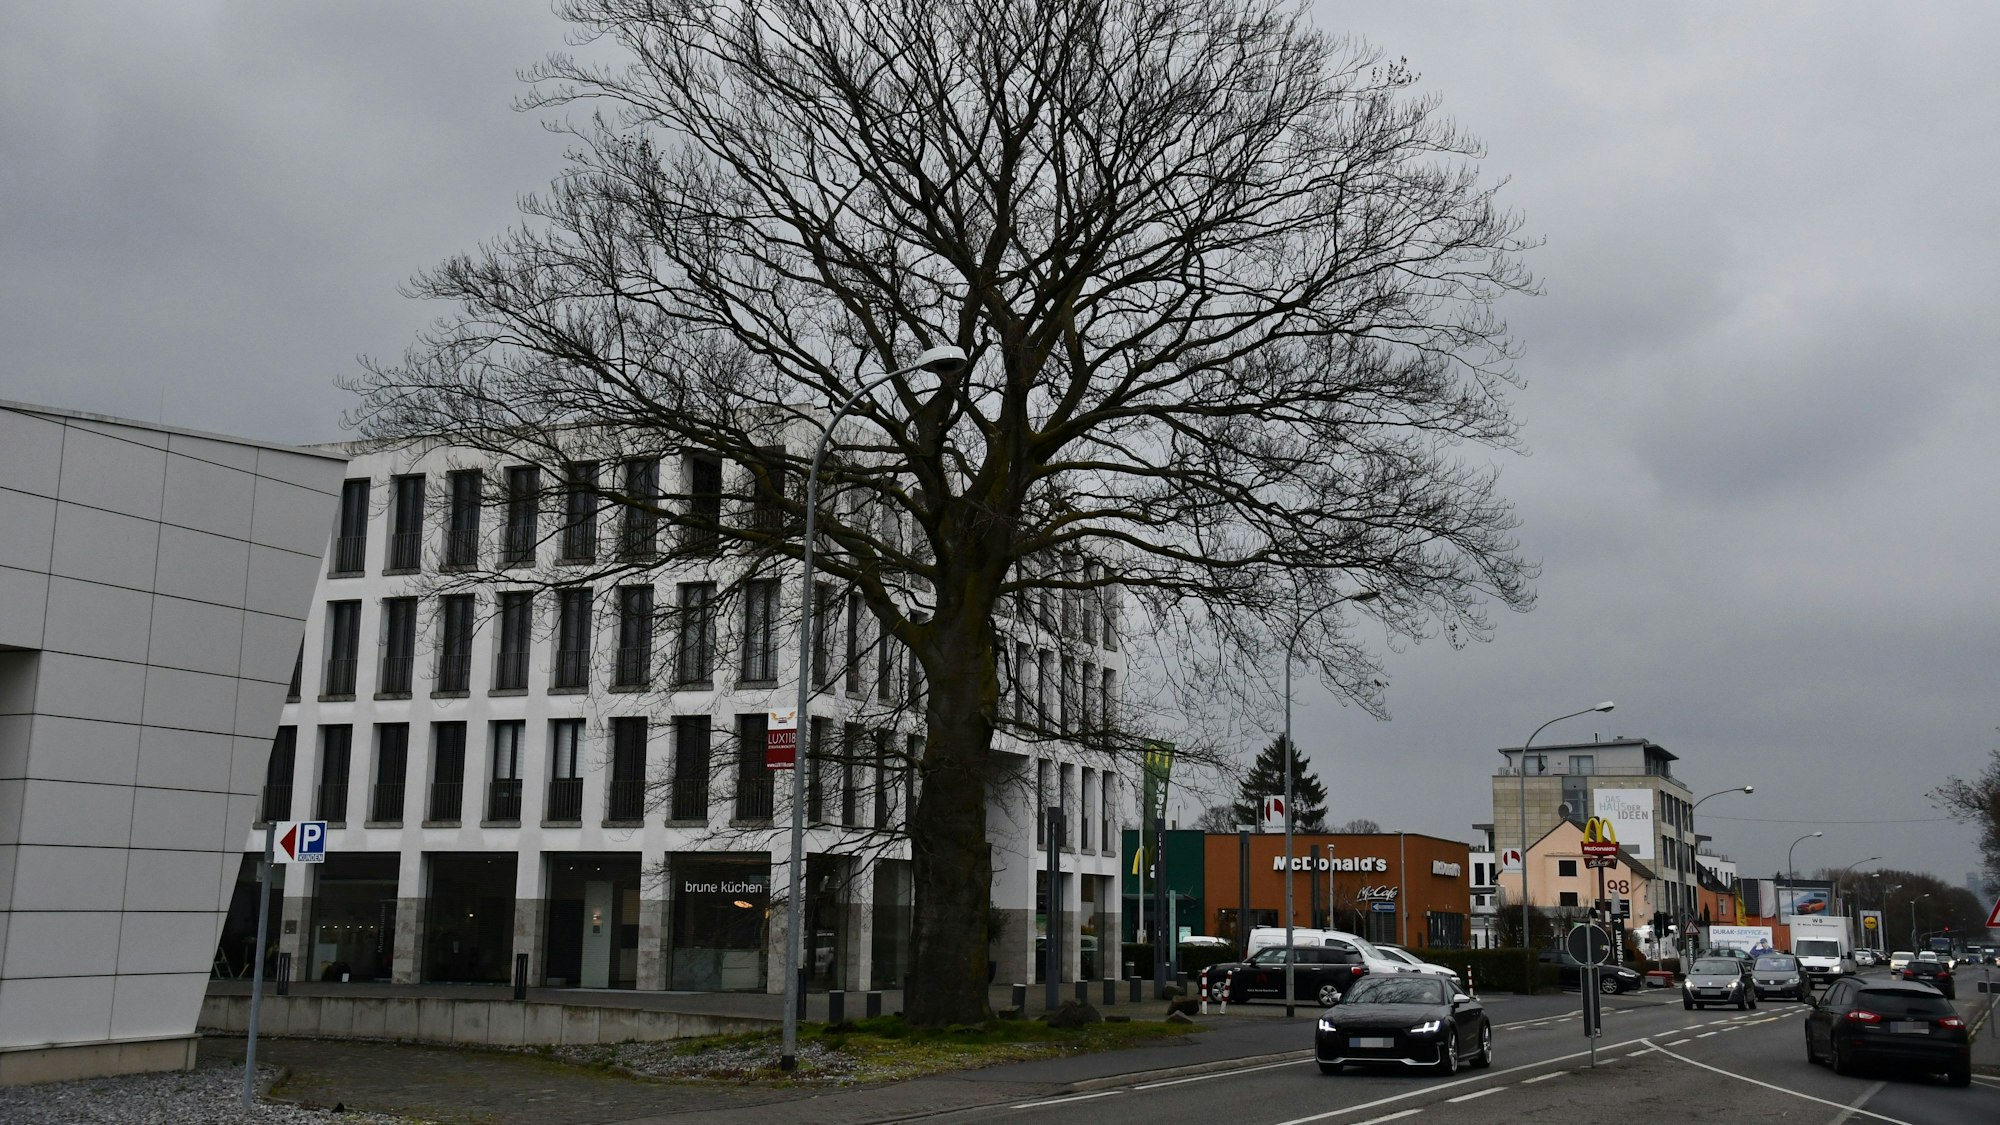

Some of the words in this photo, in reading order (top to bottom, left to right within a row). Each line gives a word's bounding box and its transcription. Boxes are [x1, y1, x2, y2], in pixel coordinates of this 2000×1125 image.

[768, 733, 796, 744] LUX118
[1600, 803, 1626, 811] HAUS
[1618, 811, 1648, 819] IDEEN
[302, 824, 321, 852] P
[1273, 856, 1387, 872] McDonald's
[685, 881, 718, 892] brune
[721, 881, 762, 893] küchen
[1607, 879, 1629, 894] 98
